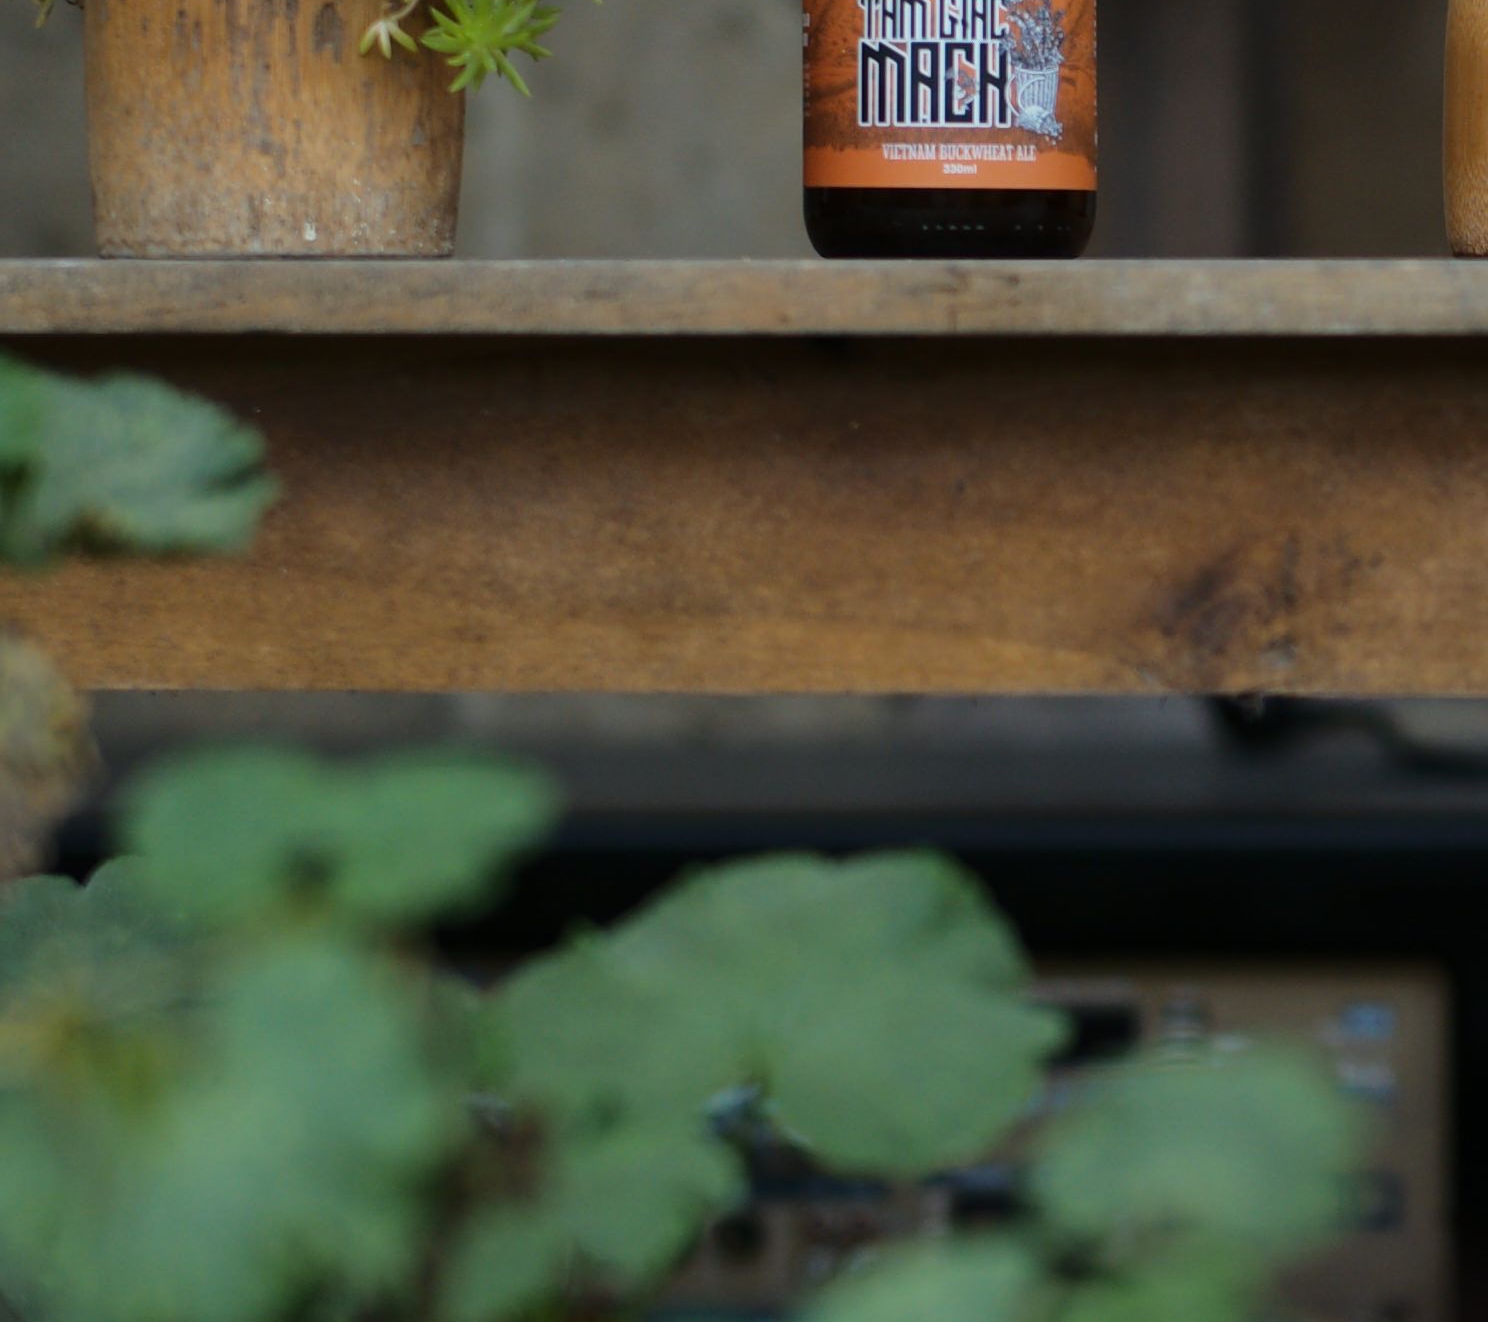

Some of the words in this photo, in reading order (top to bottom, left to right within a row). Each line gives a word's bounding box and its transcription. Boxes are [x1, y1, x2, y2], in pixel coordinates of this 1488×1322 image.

[882, 143, 937, 161] VIETNAM
[939, 143, 1014, 161] BUCKWHEAT
[1016, 144, 1037, 161] ALE
